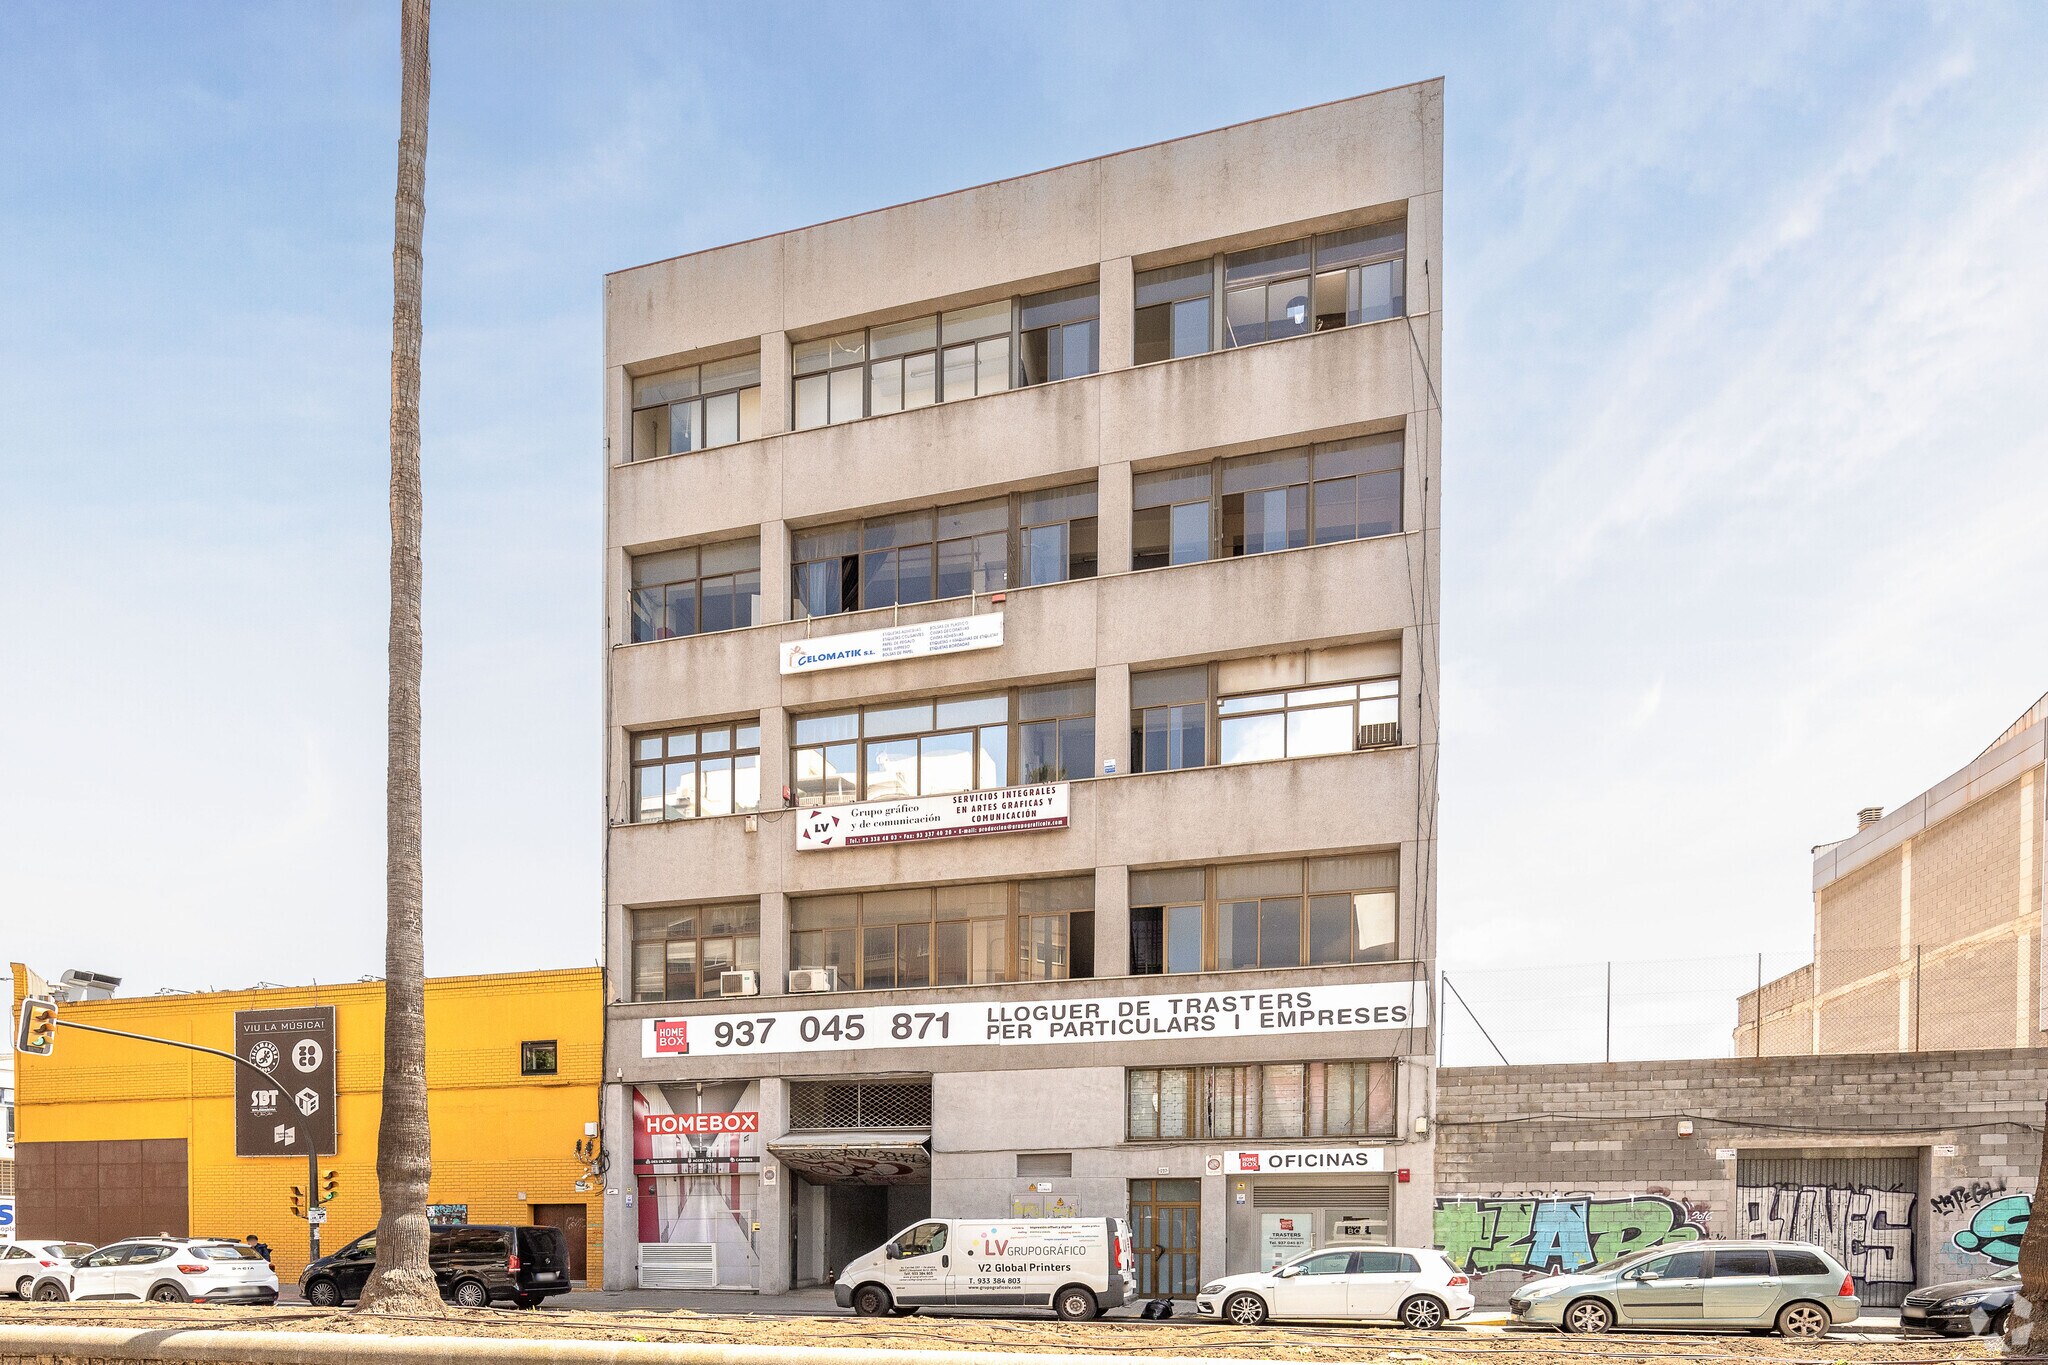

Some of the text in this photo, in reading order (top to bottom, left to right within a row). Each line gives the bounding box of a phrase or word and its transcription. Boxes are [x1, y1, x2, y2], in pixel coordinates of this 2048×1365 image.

[798, 649, 861, 666] CELOMATIK
[952, 786, 1056, 804] SERVICIOS INTEGRALES
[851, 804, 919, 819] Grupo gráfico
[957, 806, 967, 814] EN
[971, 803, 998, 813] ARTES
[1001, 798, 1043, 810] GRAFICAS
[851, 813, 941, 832] y de comunicación
[972, 809, 1037, 823] COMUNICACIÓN
[814, 823, 830, 833] LV
[987, 992, 1312, 1022] LLOGUER DE TRASTERS
[244, 1024, 260, 1032] VIU
[281, 1021, 324, 1030] MÚSICA!
[715, 1012, 949, 1047] 937 045 871
[987, 1005, 1408, 1040] PER PARTICULARS I EMPRESES
[659, 1027, 684, 1037] HOME
[659, 1037, 684, 1047] BOX
[647, 1114, 755, 1132] HOMEBOX
[1269, 1153, 1368, 1167] OFICINAS
[1692, 1211, 1713, 1220] 2016
[985, 1239, 1008, 1256] LV
[978, 1263, 1071, 1272] V2 Global Printers
